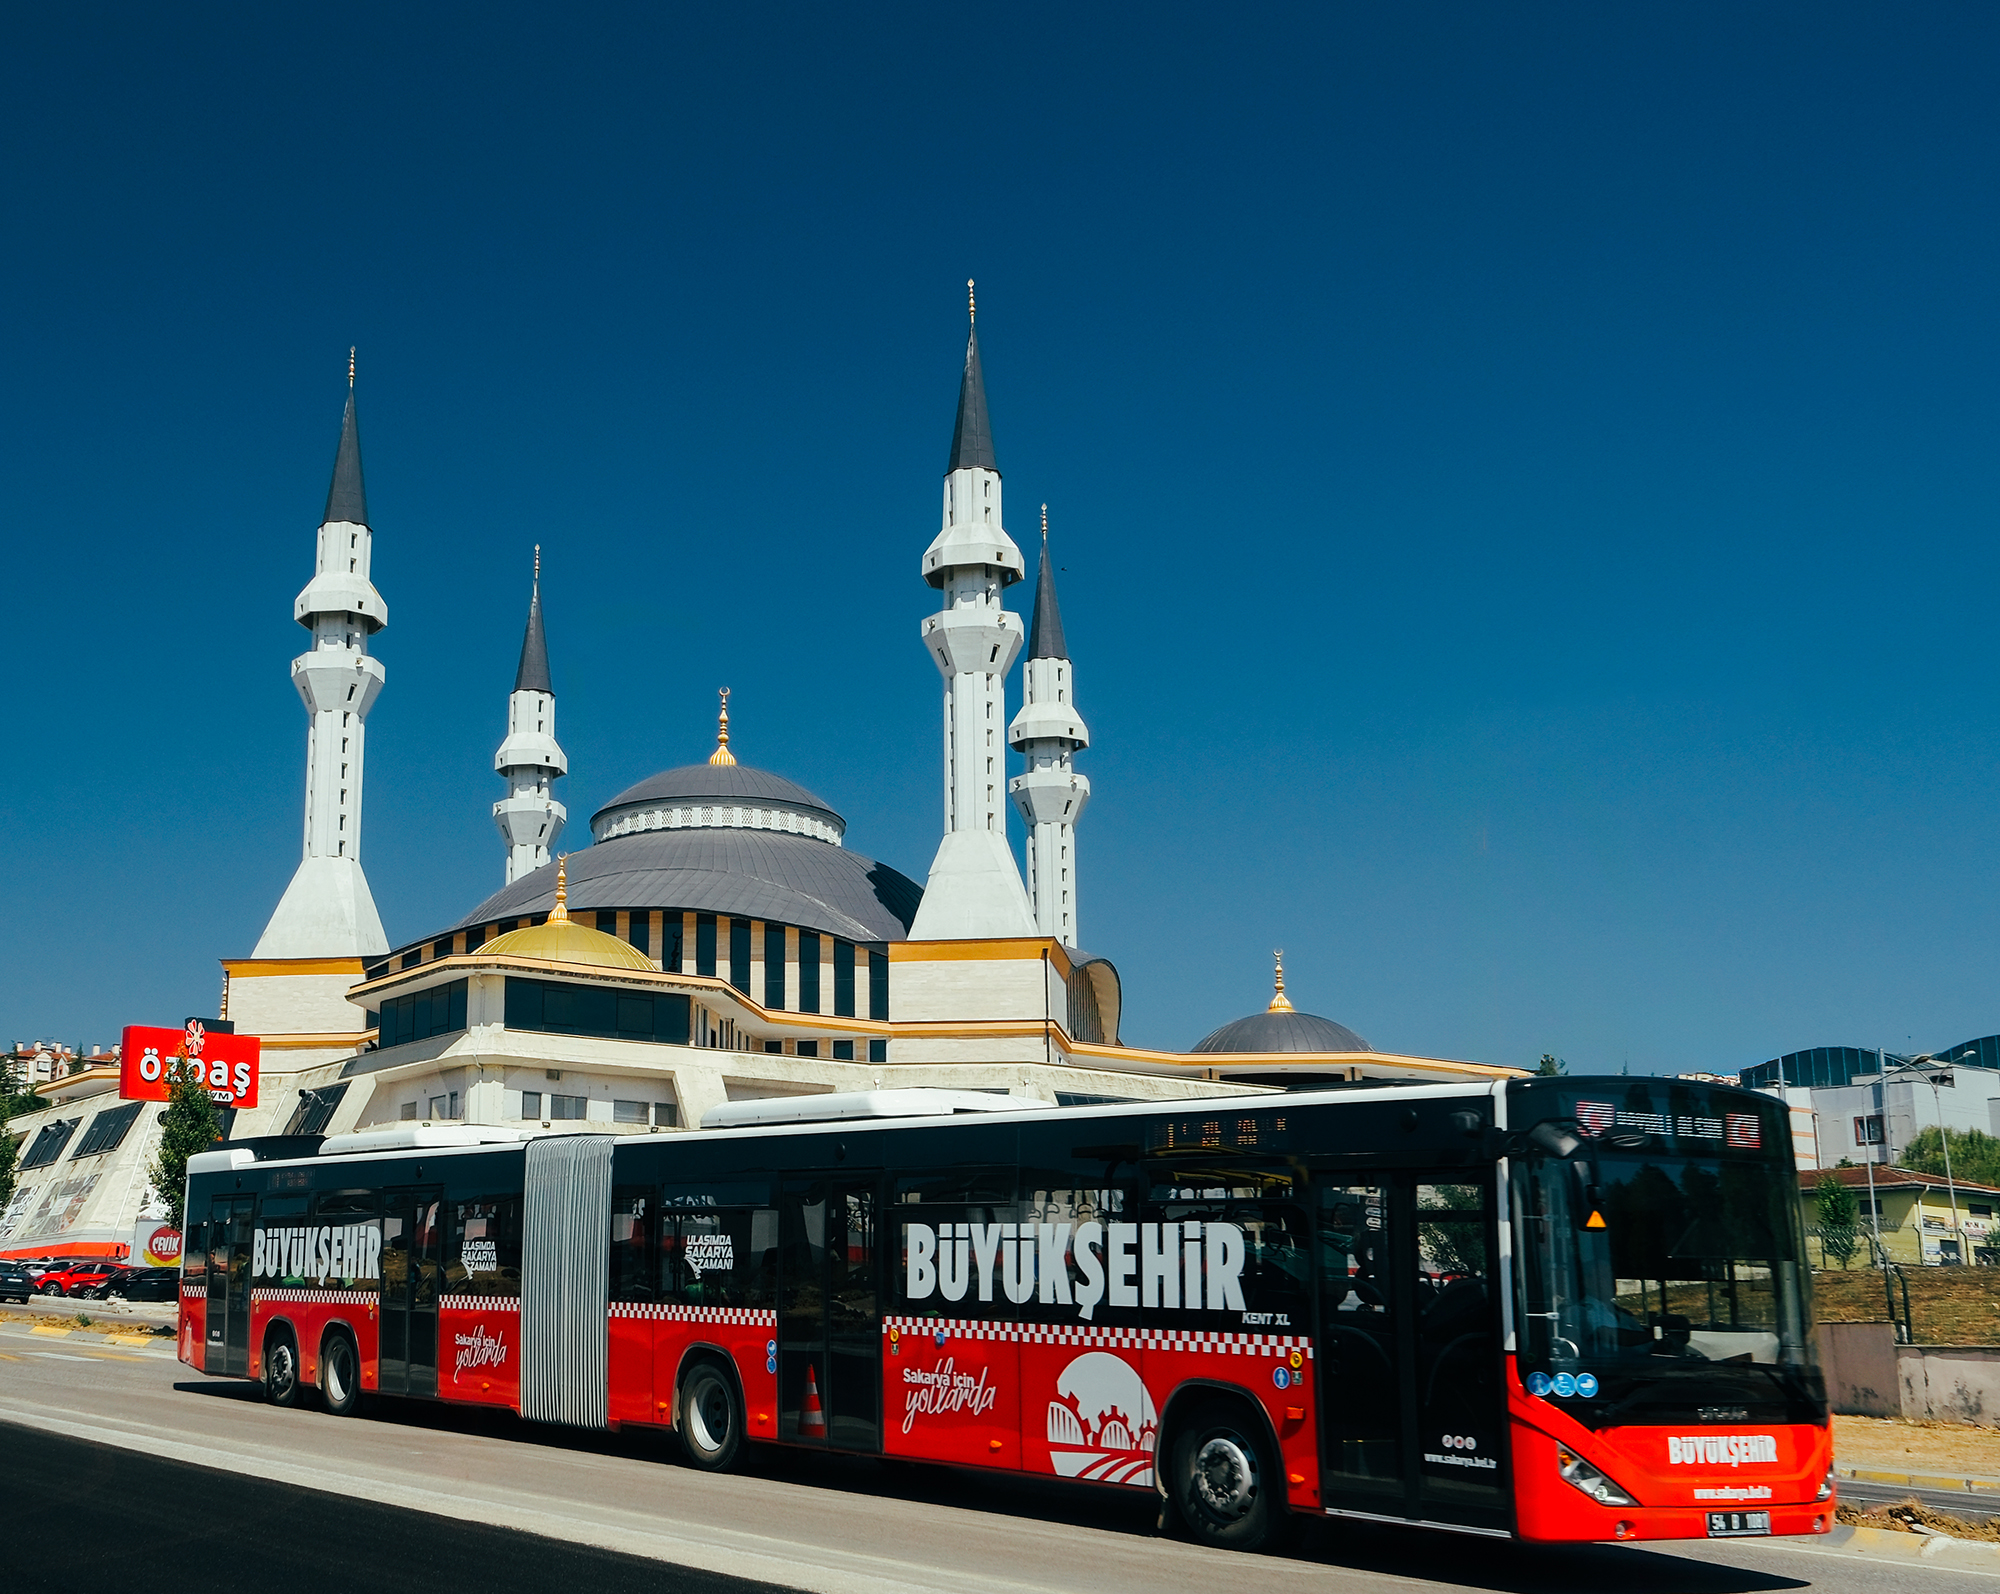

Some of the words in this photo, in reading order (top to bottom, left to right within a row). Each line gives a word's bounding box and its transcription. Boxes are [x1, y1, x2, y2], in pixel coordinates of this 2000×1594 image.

[252, 1225, 381, 1287] BÜYÜKŞEHİR
[461, 1250, 497, 1262] SAKARYA
[685, 1245, 734, 1259] SAKARYA
[470, 1261, 497, 1272] ZAMANI
[697, 1258, 734, 1270] ZAMANI
[906, 1221, 1247, 1320] BÜYÜKŞEHİR
[1241, 1312, 1274, 1325] KENT
[1274, 1313, 1291, 1326] XL
[903, 1367, 951, 1389] Sakarya
[902, 1357, 996, 1434] yollarda
[1667, 1434, 1778, 1468] BÜYÜKŞEHİR
